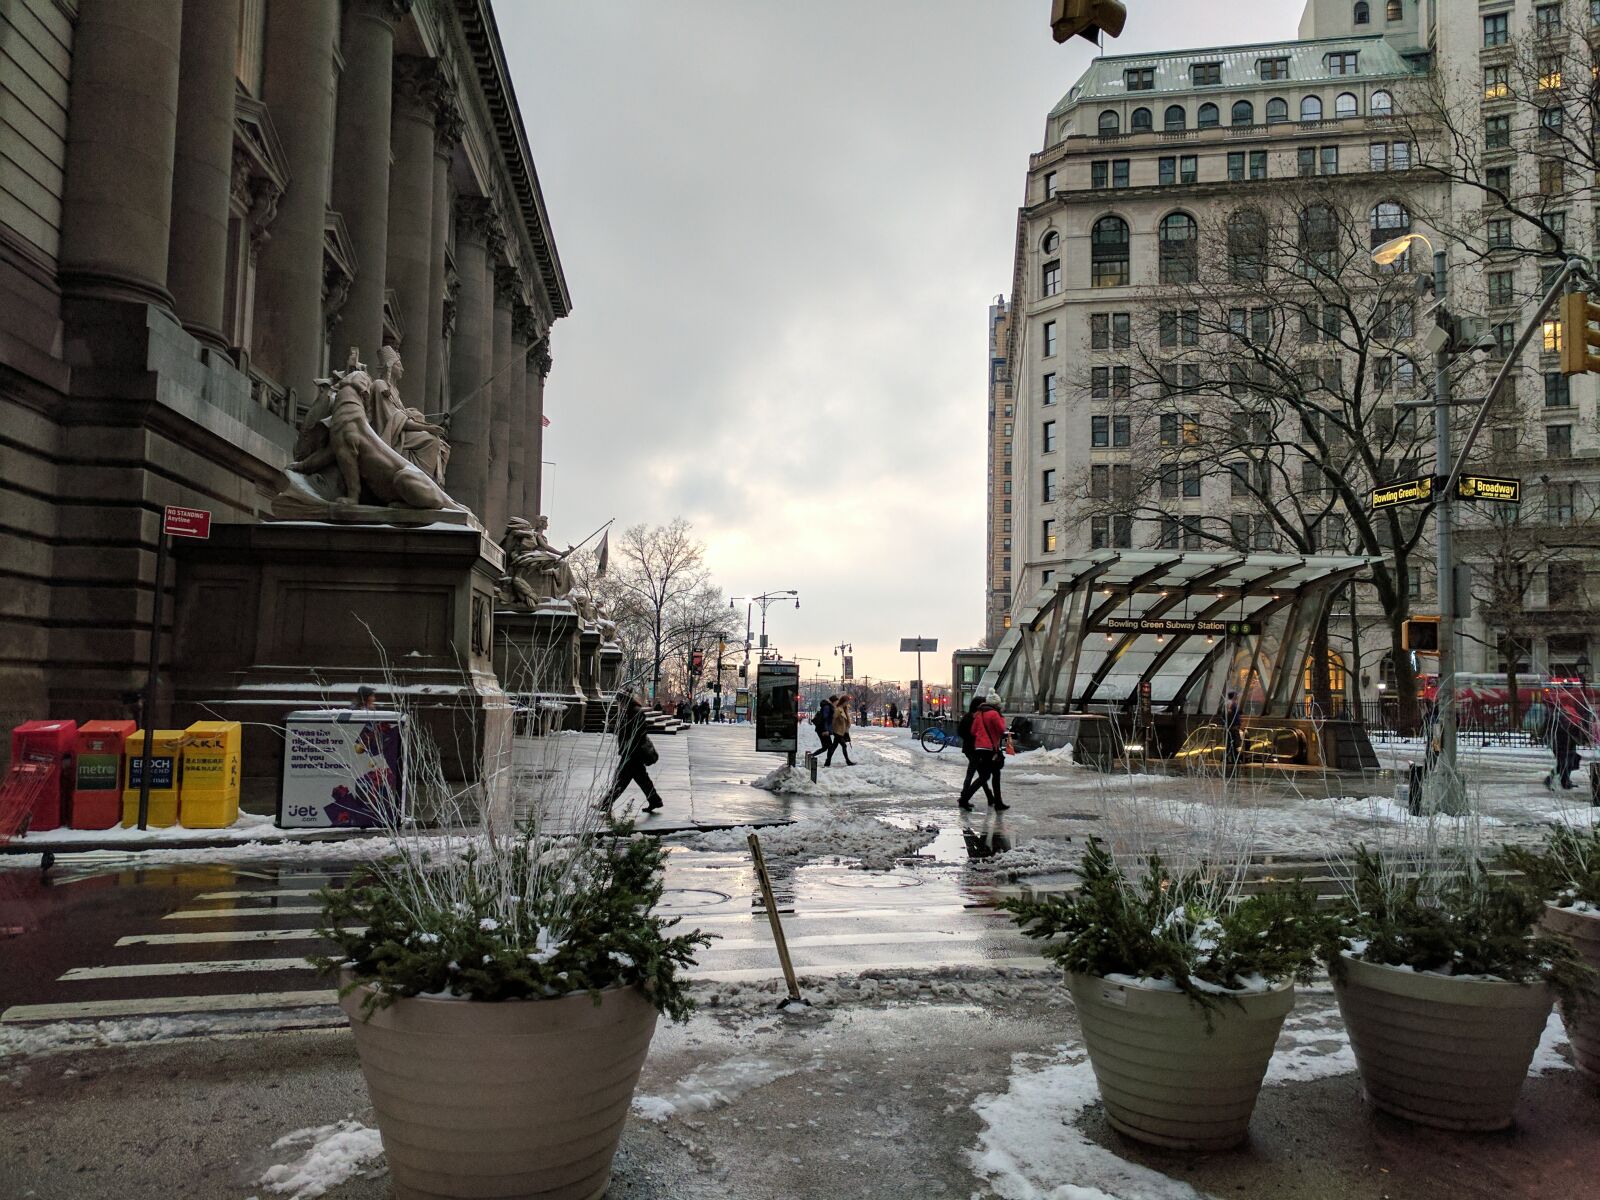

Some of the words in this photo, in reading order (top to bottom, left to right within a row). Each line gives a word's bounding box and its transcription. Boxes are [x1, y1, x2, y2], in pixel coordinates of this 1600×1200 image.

[1477, 481, 1515, 497] Broadway
[1374, 491, 1398, 503] Bowling
[1398, 488, 1417, 499] Green
[168, 515, 190, 523] Anytime
[177, 510, 204, 518] STANDING
[1108, 619, 1139, 629] Bowling
[1140, 620, 1164, 629] Green
[1165, 620, 1196, 630] Subway
[1197, 621, 1225, 630] Station
[79, 764, 116, 774] metro
[288, 805, 318, 817] jet
